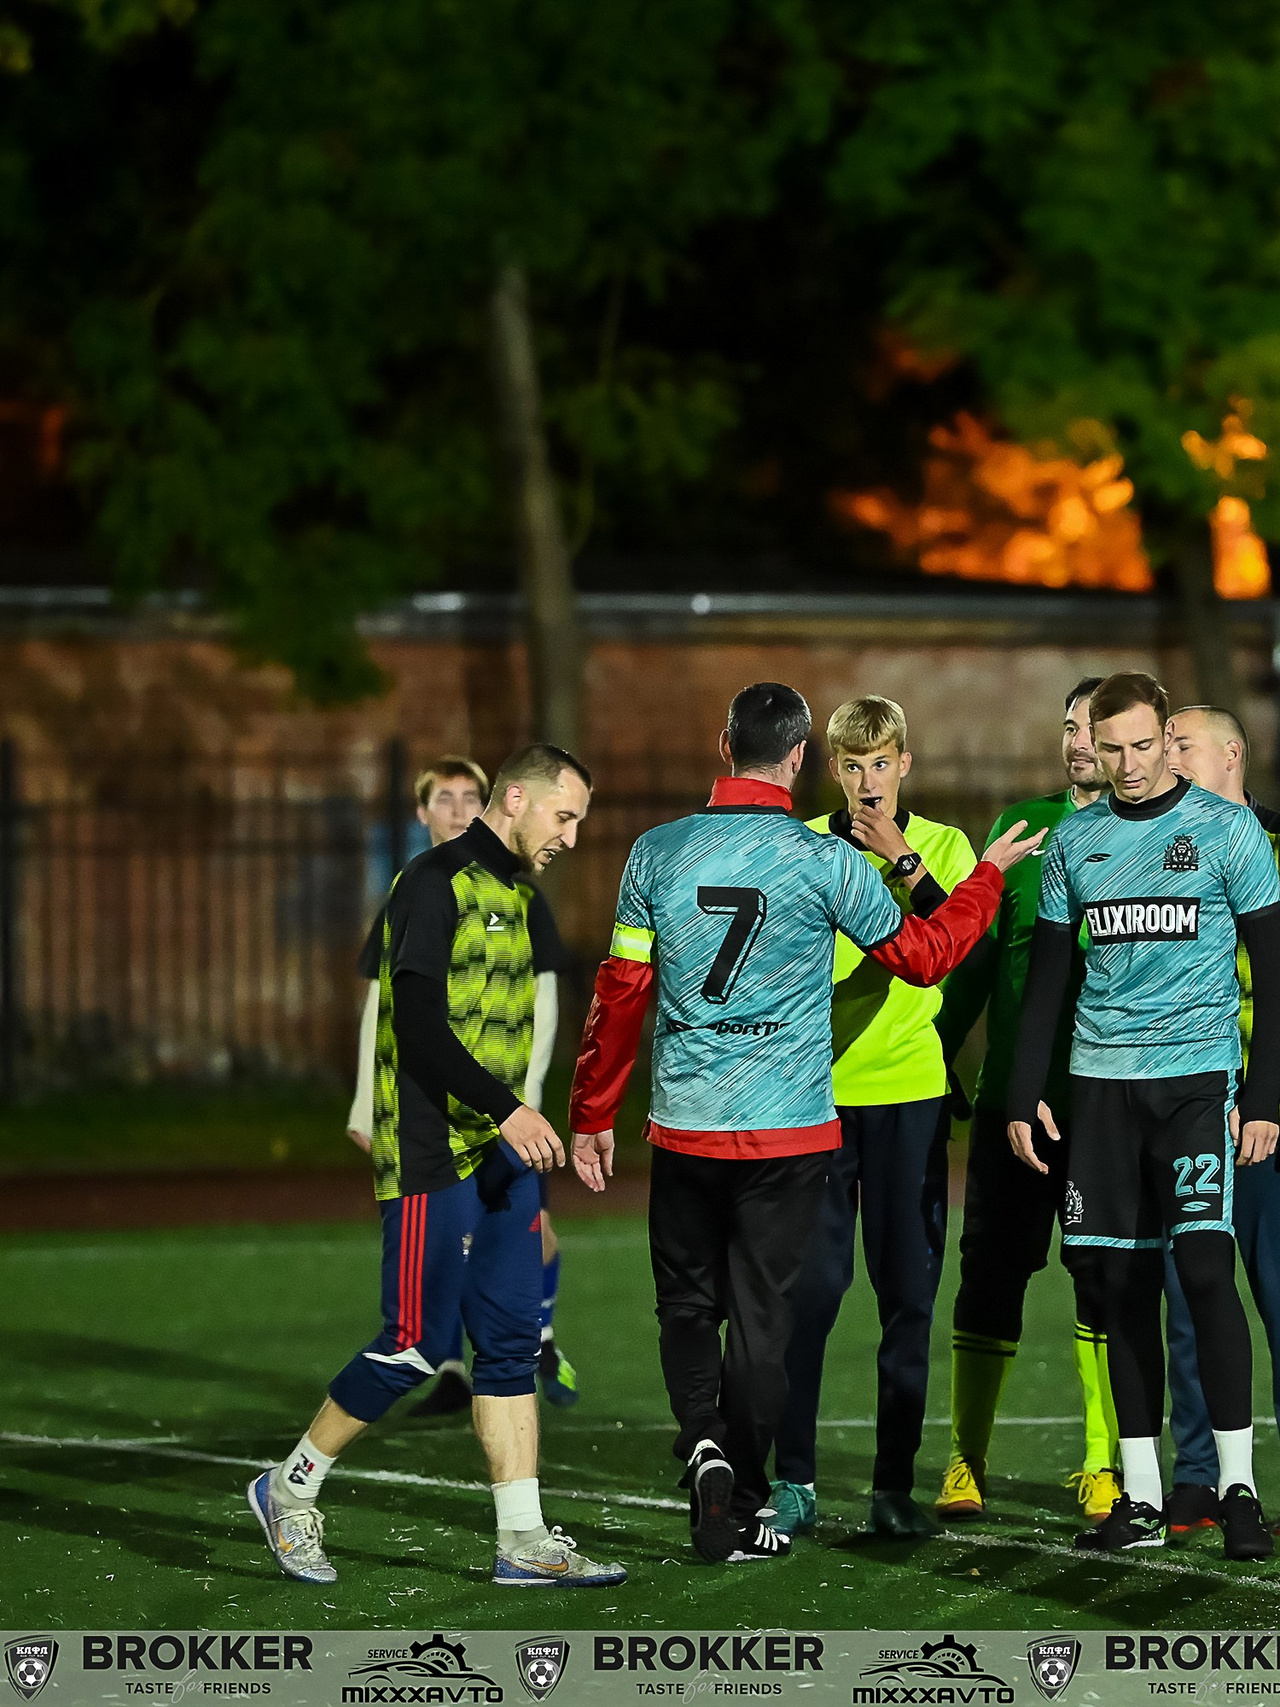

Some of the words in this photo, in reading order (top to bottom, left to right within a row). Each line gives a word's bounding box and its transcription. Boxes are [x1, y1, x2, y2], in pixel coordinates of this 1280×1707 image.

[1085, 903, 1198, 937] ELIXIROOM
[697, 885, 767, 1005] 7
[1173, 1154, 1220, 1197] 22
[288, 1453, 315, 1485] FLA
